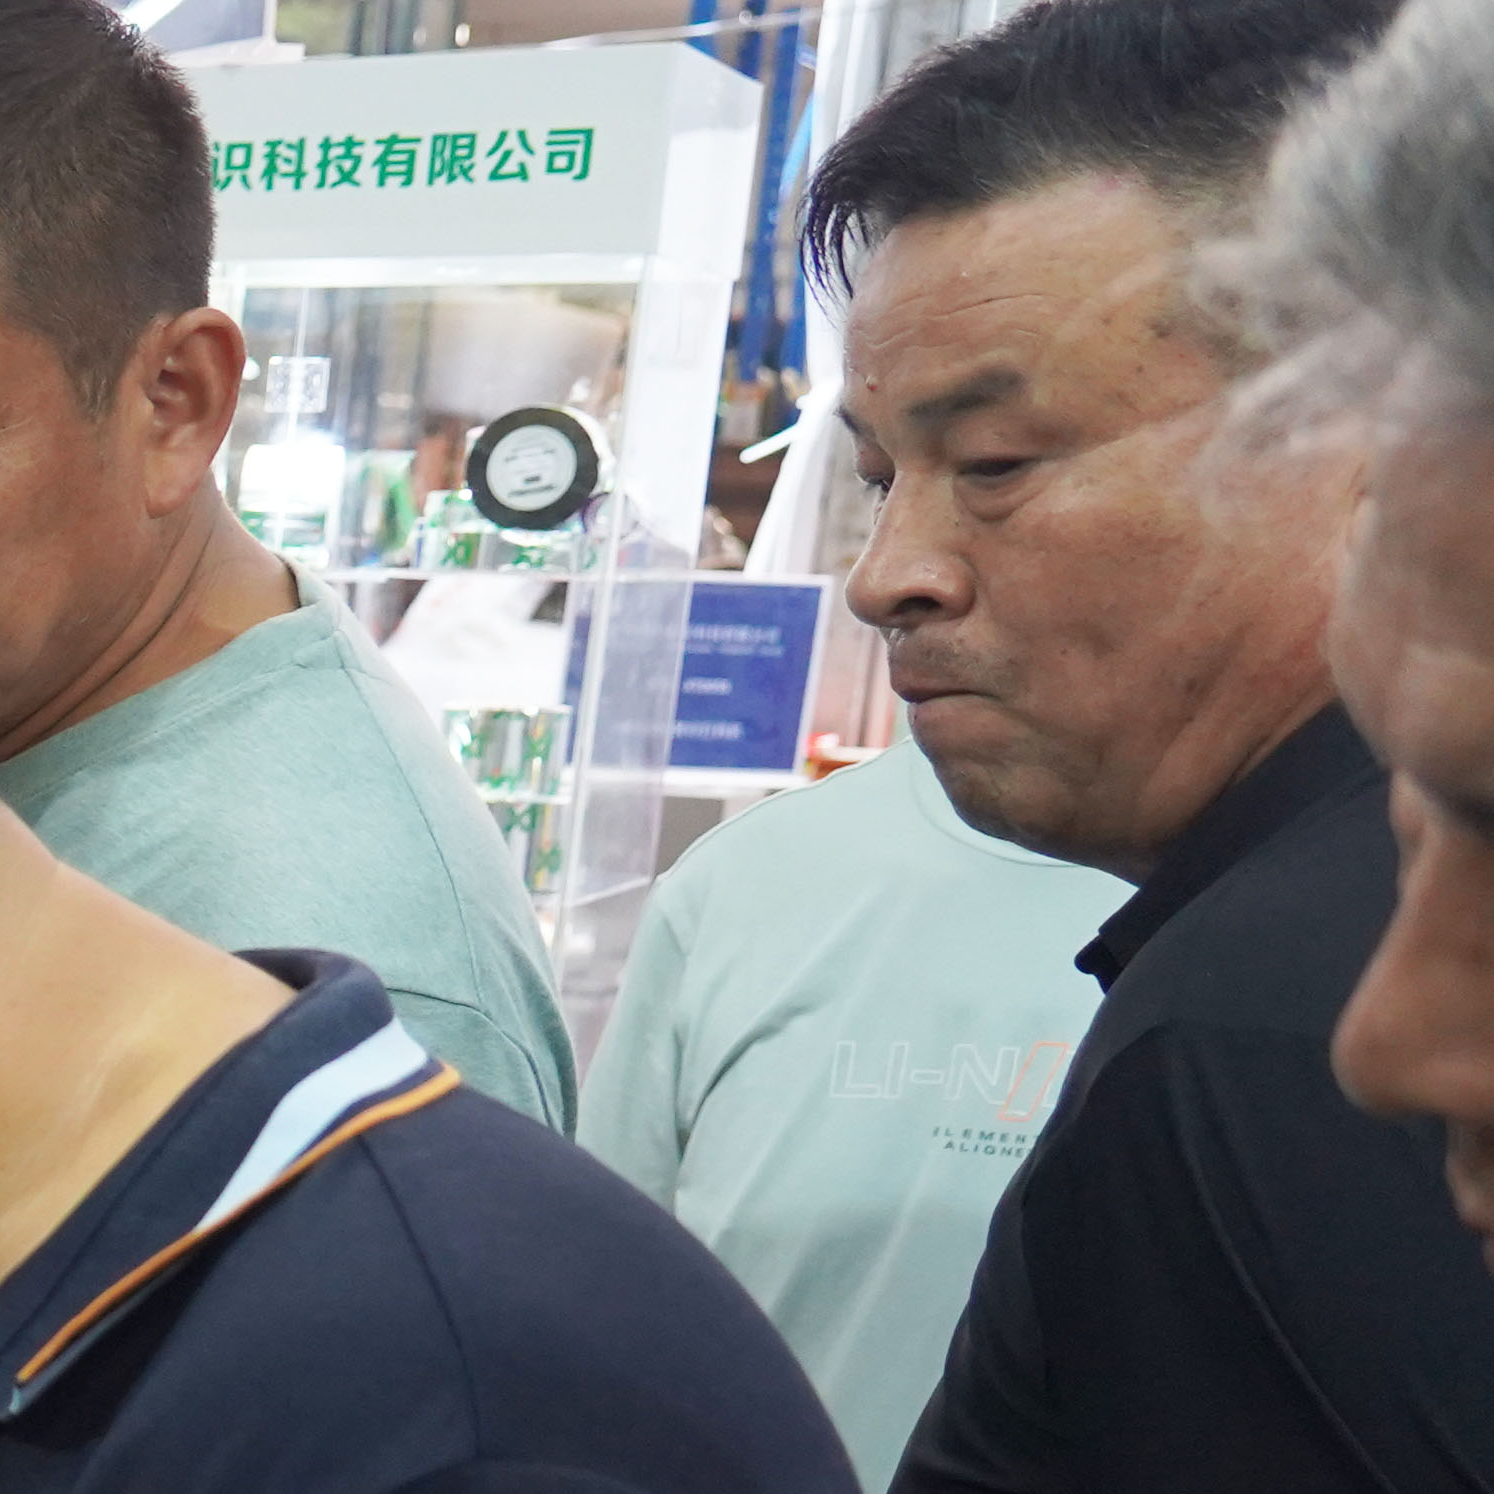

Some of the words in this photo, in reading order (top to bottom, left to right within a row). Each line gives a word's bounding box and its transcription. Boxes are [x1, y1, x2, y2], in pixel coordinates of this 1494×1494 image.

[213, 127, 594, 192] 识科技有限公司
